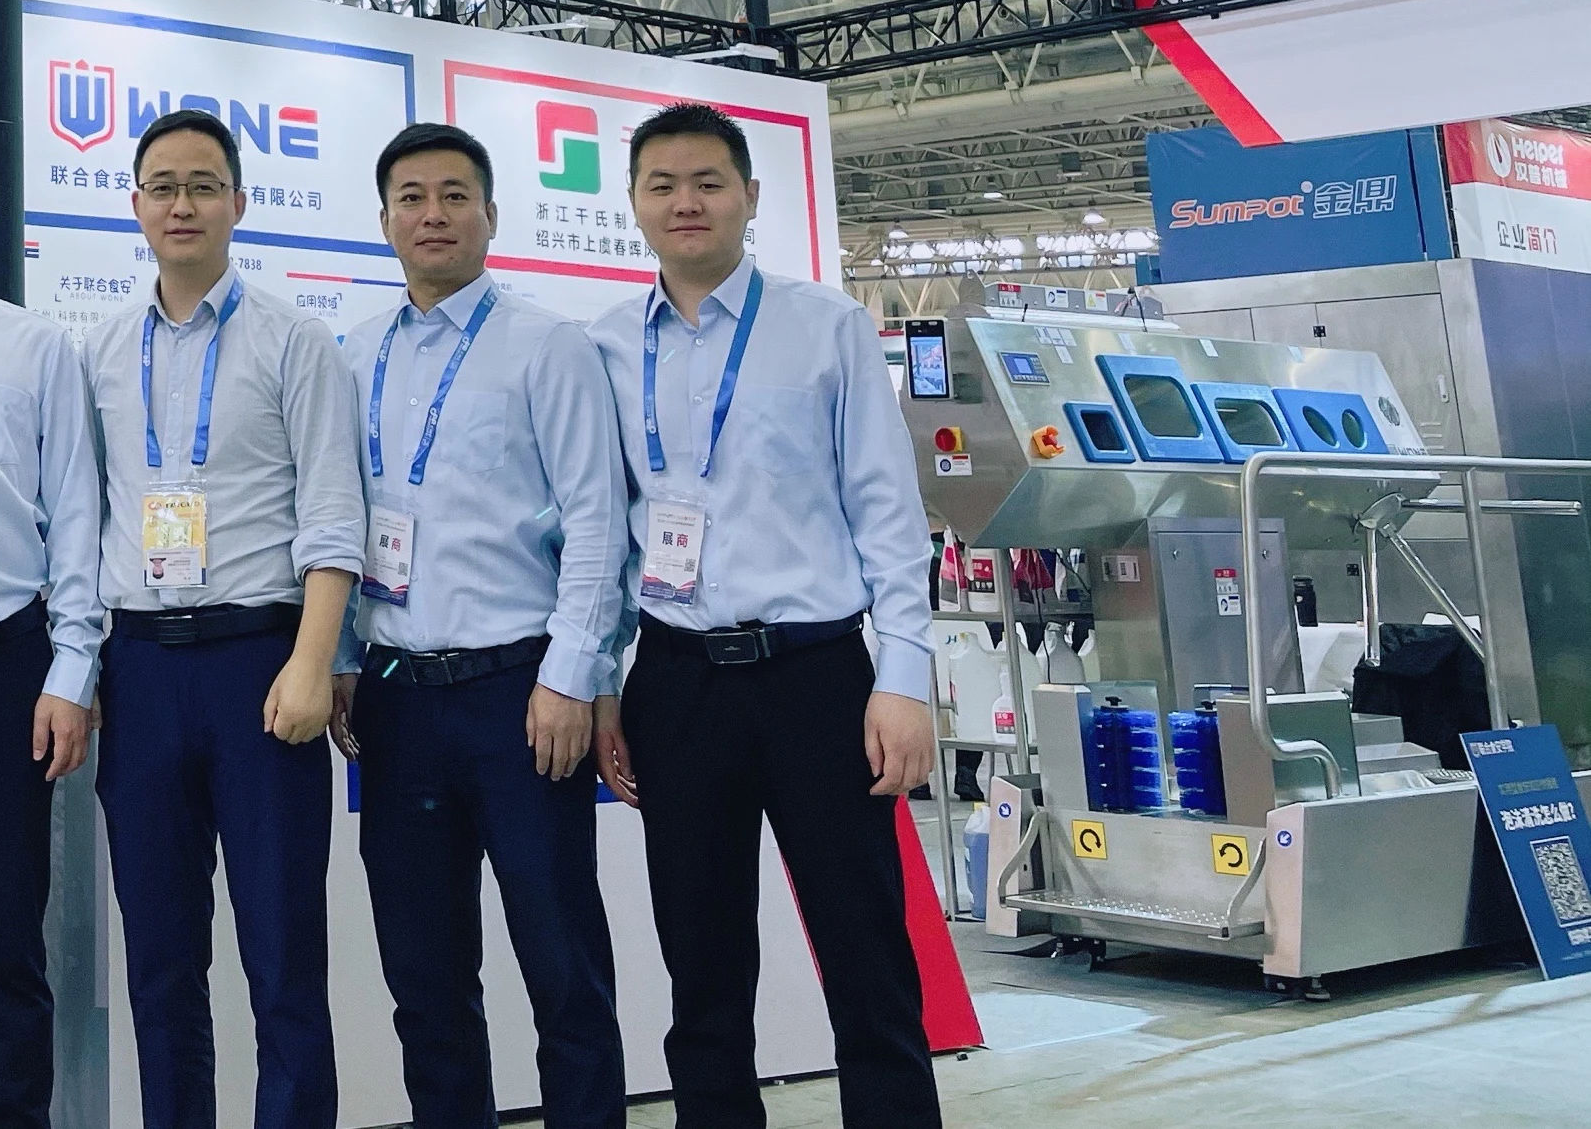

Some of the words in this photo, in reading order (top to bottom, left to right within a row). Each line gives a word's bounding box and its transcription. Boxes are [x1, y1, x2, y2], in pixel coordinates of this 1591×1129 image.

[1511, 136, 1564, 166] Helper
[50, 164, 132, 191] 联合食安
[243, 185, 323, 211] 有限公司
[1312, 174, 1397, 219] 金鼎
[535, 201, 639, 231] 浙江干氏制
[1497, 220, 1557, 254] 企业简介
[59, 274, 132, 294] 关于联合食安
[70, 292, 97, 301] ABOUT
[100, 294, 124, 303] WONE
[296, 294, 338, 310] 应用领域
[379, 534, 401, 552] 展商
[662, 530, 689, 548] 展商
